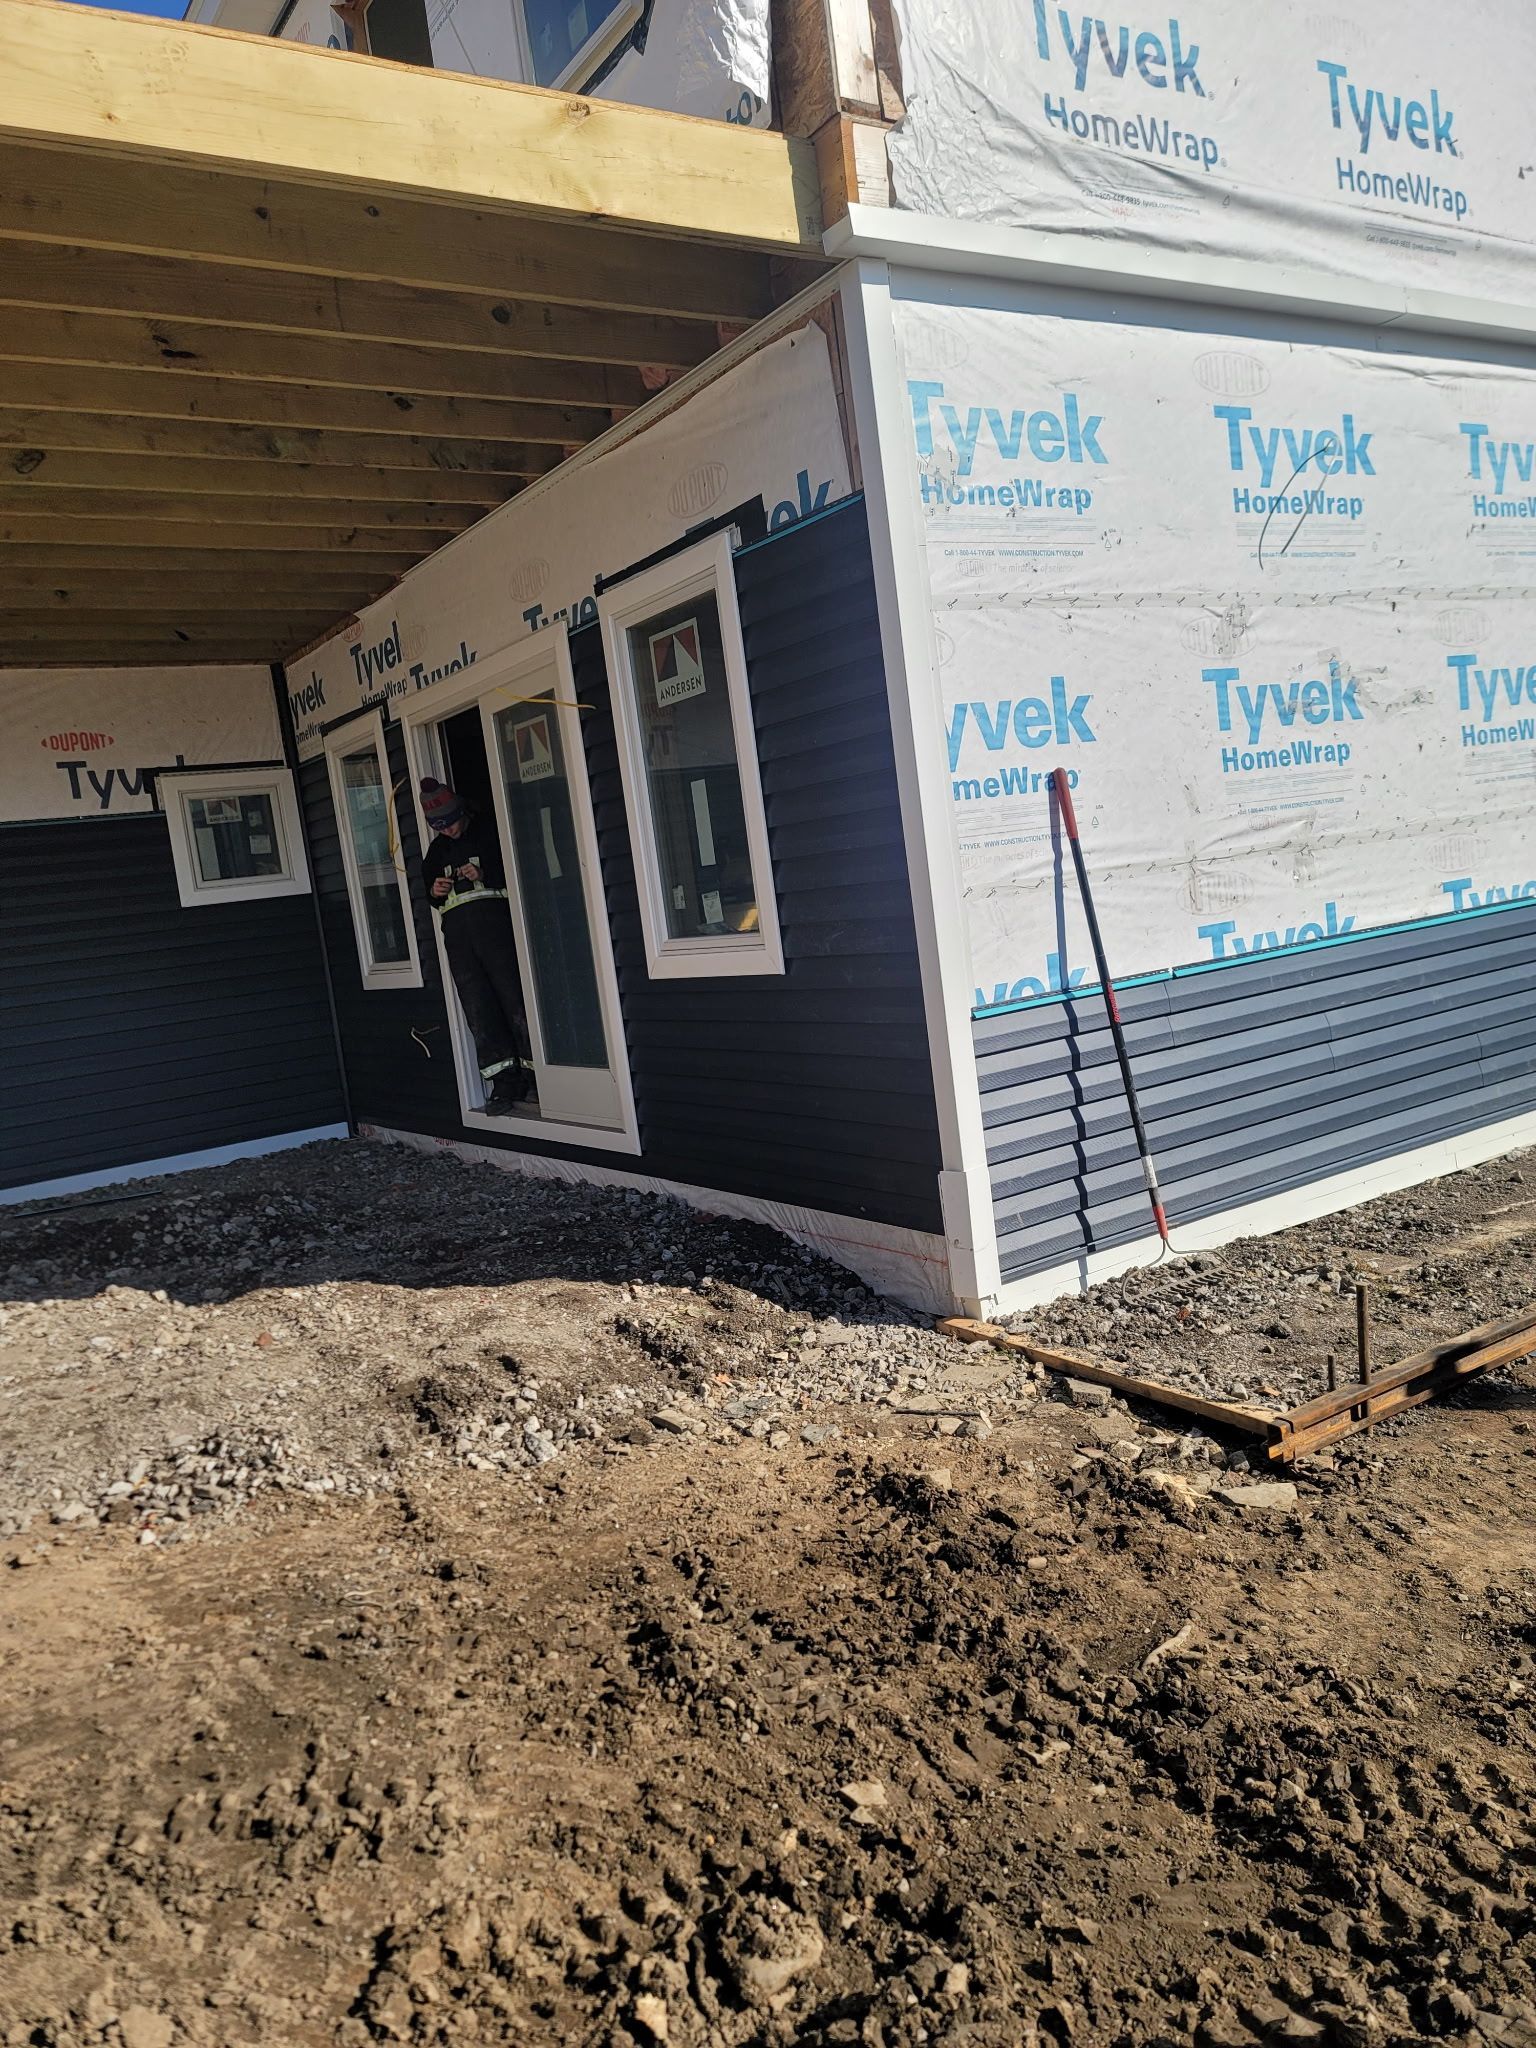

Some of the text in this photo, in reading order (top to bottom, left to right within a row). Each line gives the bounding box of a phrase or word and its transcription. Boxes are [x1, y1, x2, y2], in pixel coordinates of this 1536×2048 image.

[1044, 92, 1218, 172] HomeWrap
[1316, 59, 1458, 157] Tyvek
[1336, 157, 1467, 221] HomeWrap
[907, 380, 1109, 476] Tyvek
[1213, 405, 1376, 488] Tyvek
[920, 475, 1092, 515] HomeWrap
[1233, 487, 1363, 520] HomeWrap
[660, 675, 702, 701] ANDERSEN
[1202, 662, 1364, 745] Tyvek
[50, 731, 107, 751] DUPONT
[1222, 741, 1350, 773] HomeWrap
